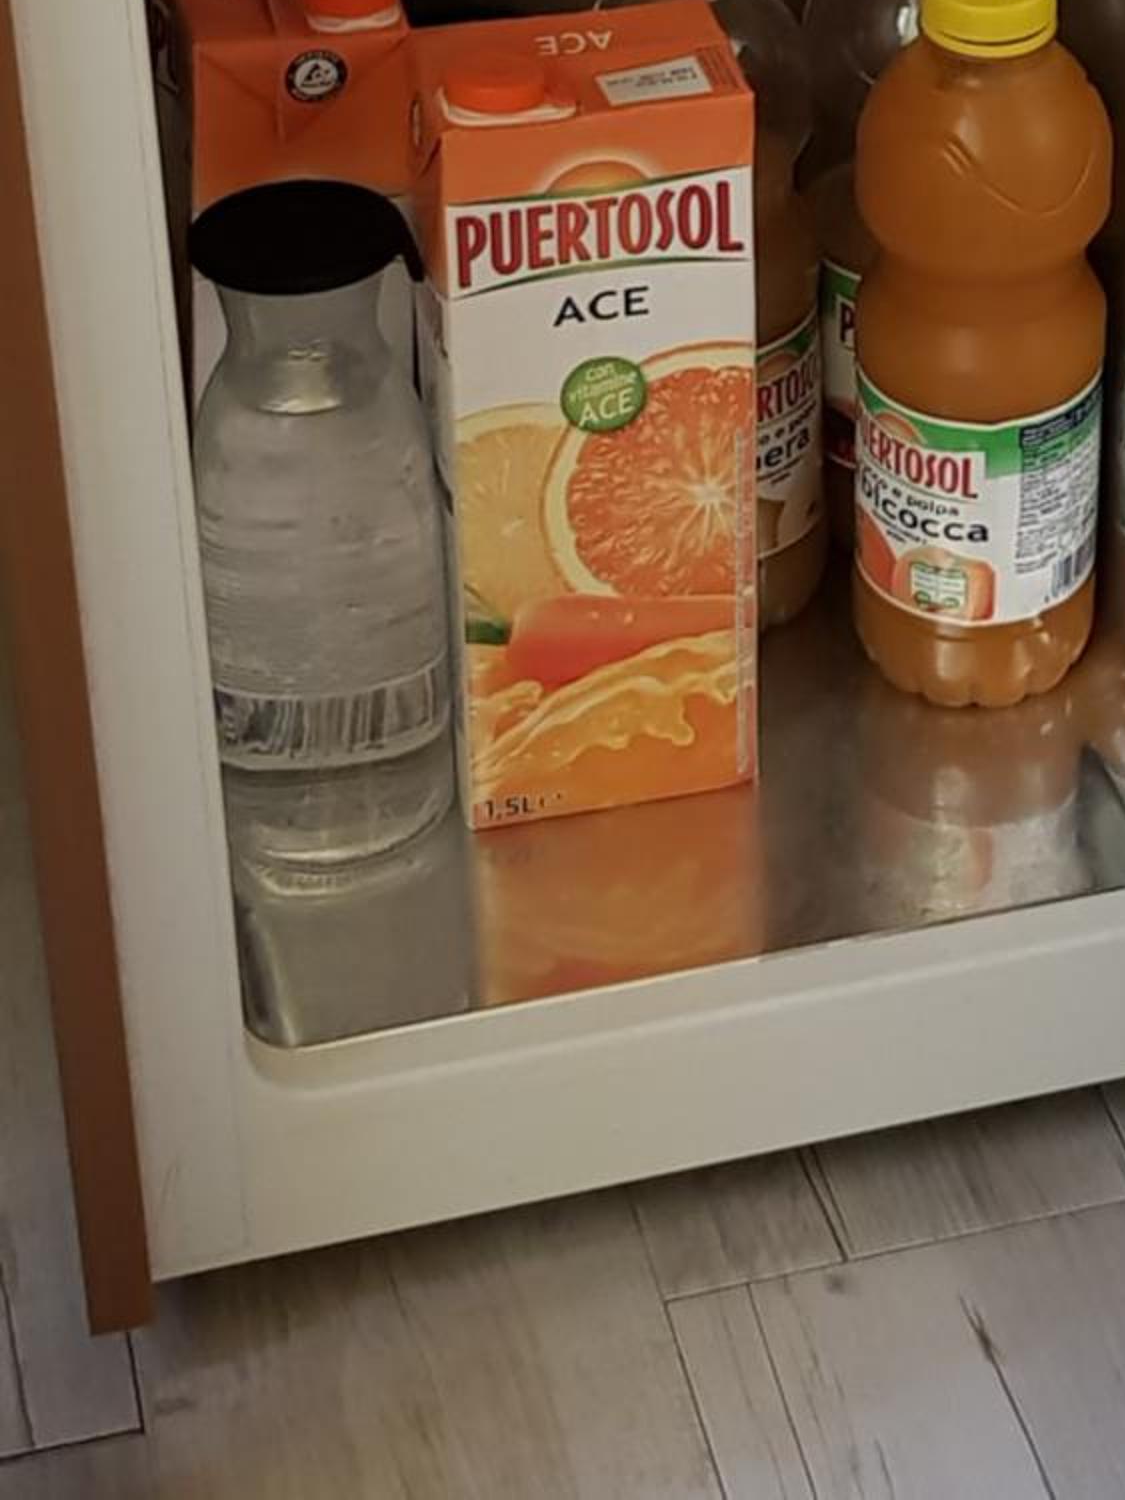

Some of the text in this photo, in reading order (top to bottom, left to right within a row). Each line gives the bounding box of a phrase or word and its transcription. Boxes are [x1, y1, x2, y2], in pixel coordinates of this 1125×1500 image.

[534, 30, 613, 56] ACE
[455, 180, 745, 289] PUERTOSOL
[552, 285, 650, 328] ACE
[578, 387, 636, 428] ACE
